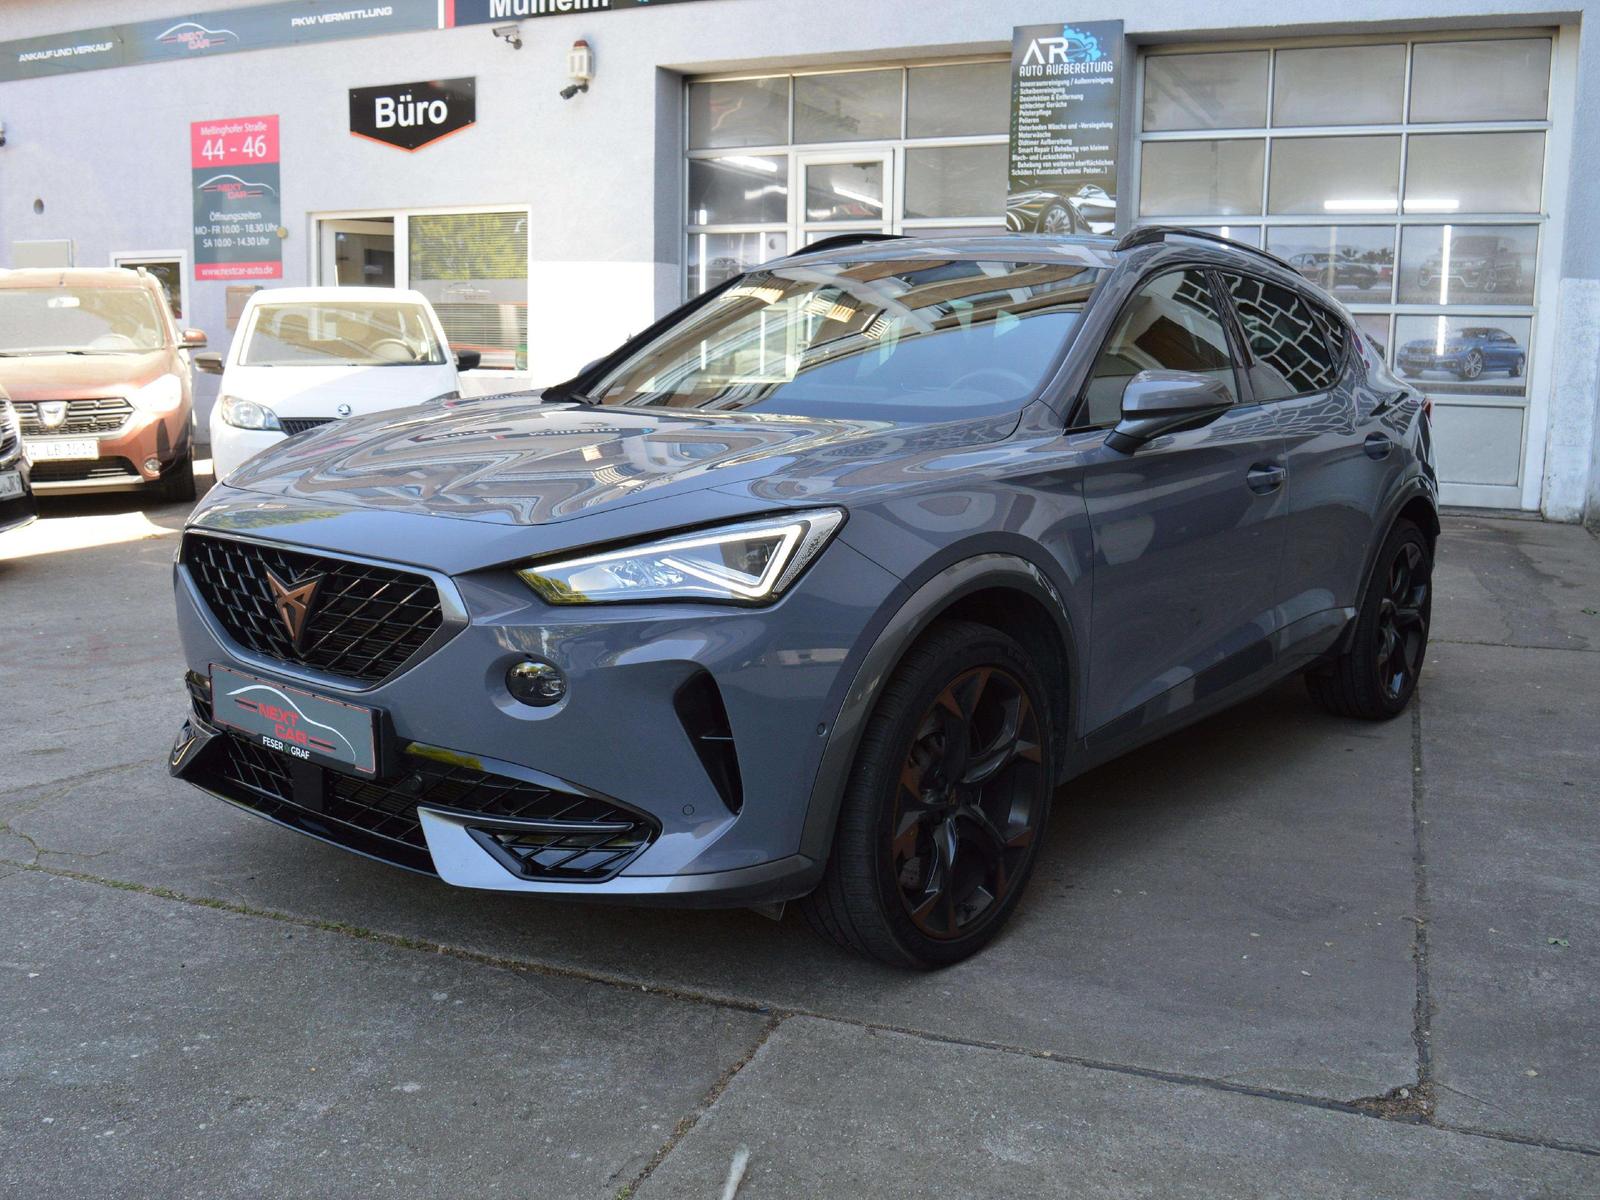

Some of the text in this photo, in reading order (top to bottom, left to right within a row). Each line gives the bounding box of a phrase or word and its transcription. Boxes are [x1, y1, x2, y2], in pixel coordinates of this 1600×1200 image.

[291, 6, 393, 27] PKW VERMITTLUNG
[177, 31, 205, 42] NEXT
[188, 38, 210, 50] CAR
[18, 42, 113, 62] ANKAUF UND VERKAUF
[1022, 38, 1069, 65] AR
[1020, 61, 1114, 77] AUTO AUFBEREITUNG
[375, 94, 448, 128] Büro
[244, 121, 267, 132] Straße
[202, 138, 225, 160] 44
[242, 134, 267, 158] 46
[210, 210, 262, 222] Öffnungszeiten
[194, 226, 207, 235] MO
[212, 225, 220, 234] FR
[202, 238, 213, 248] SA
[256, 236, 270, 246] Uhr
[259, 703, 298, 726] NEXT
[276, 725, 308, 745] CAR
[262, 736, 310, 760] FESER GRAF
